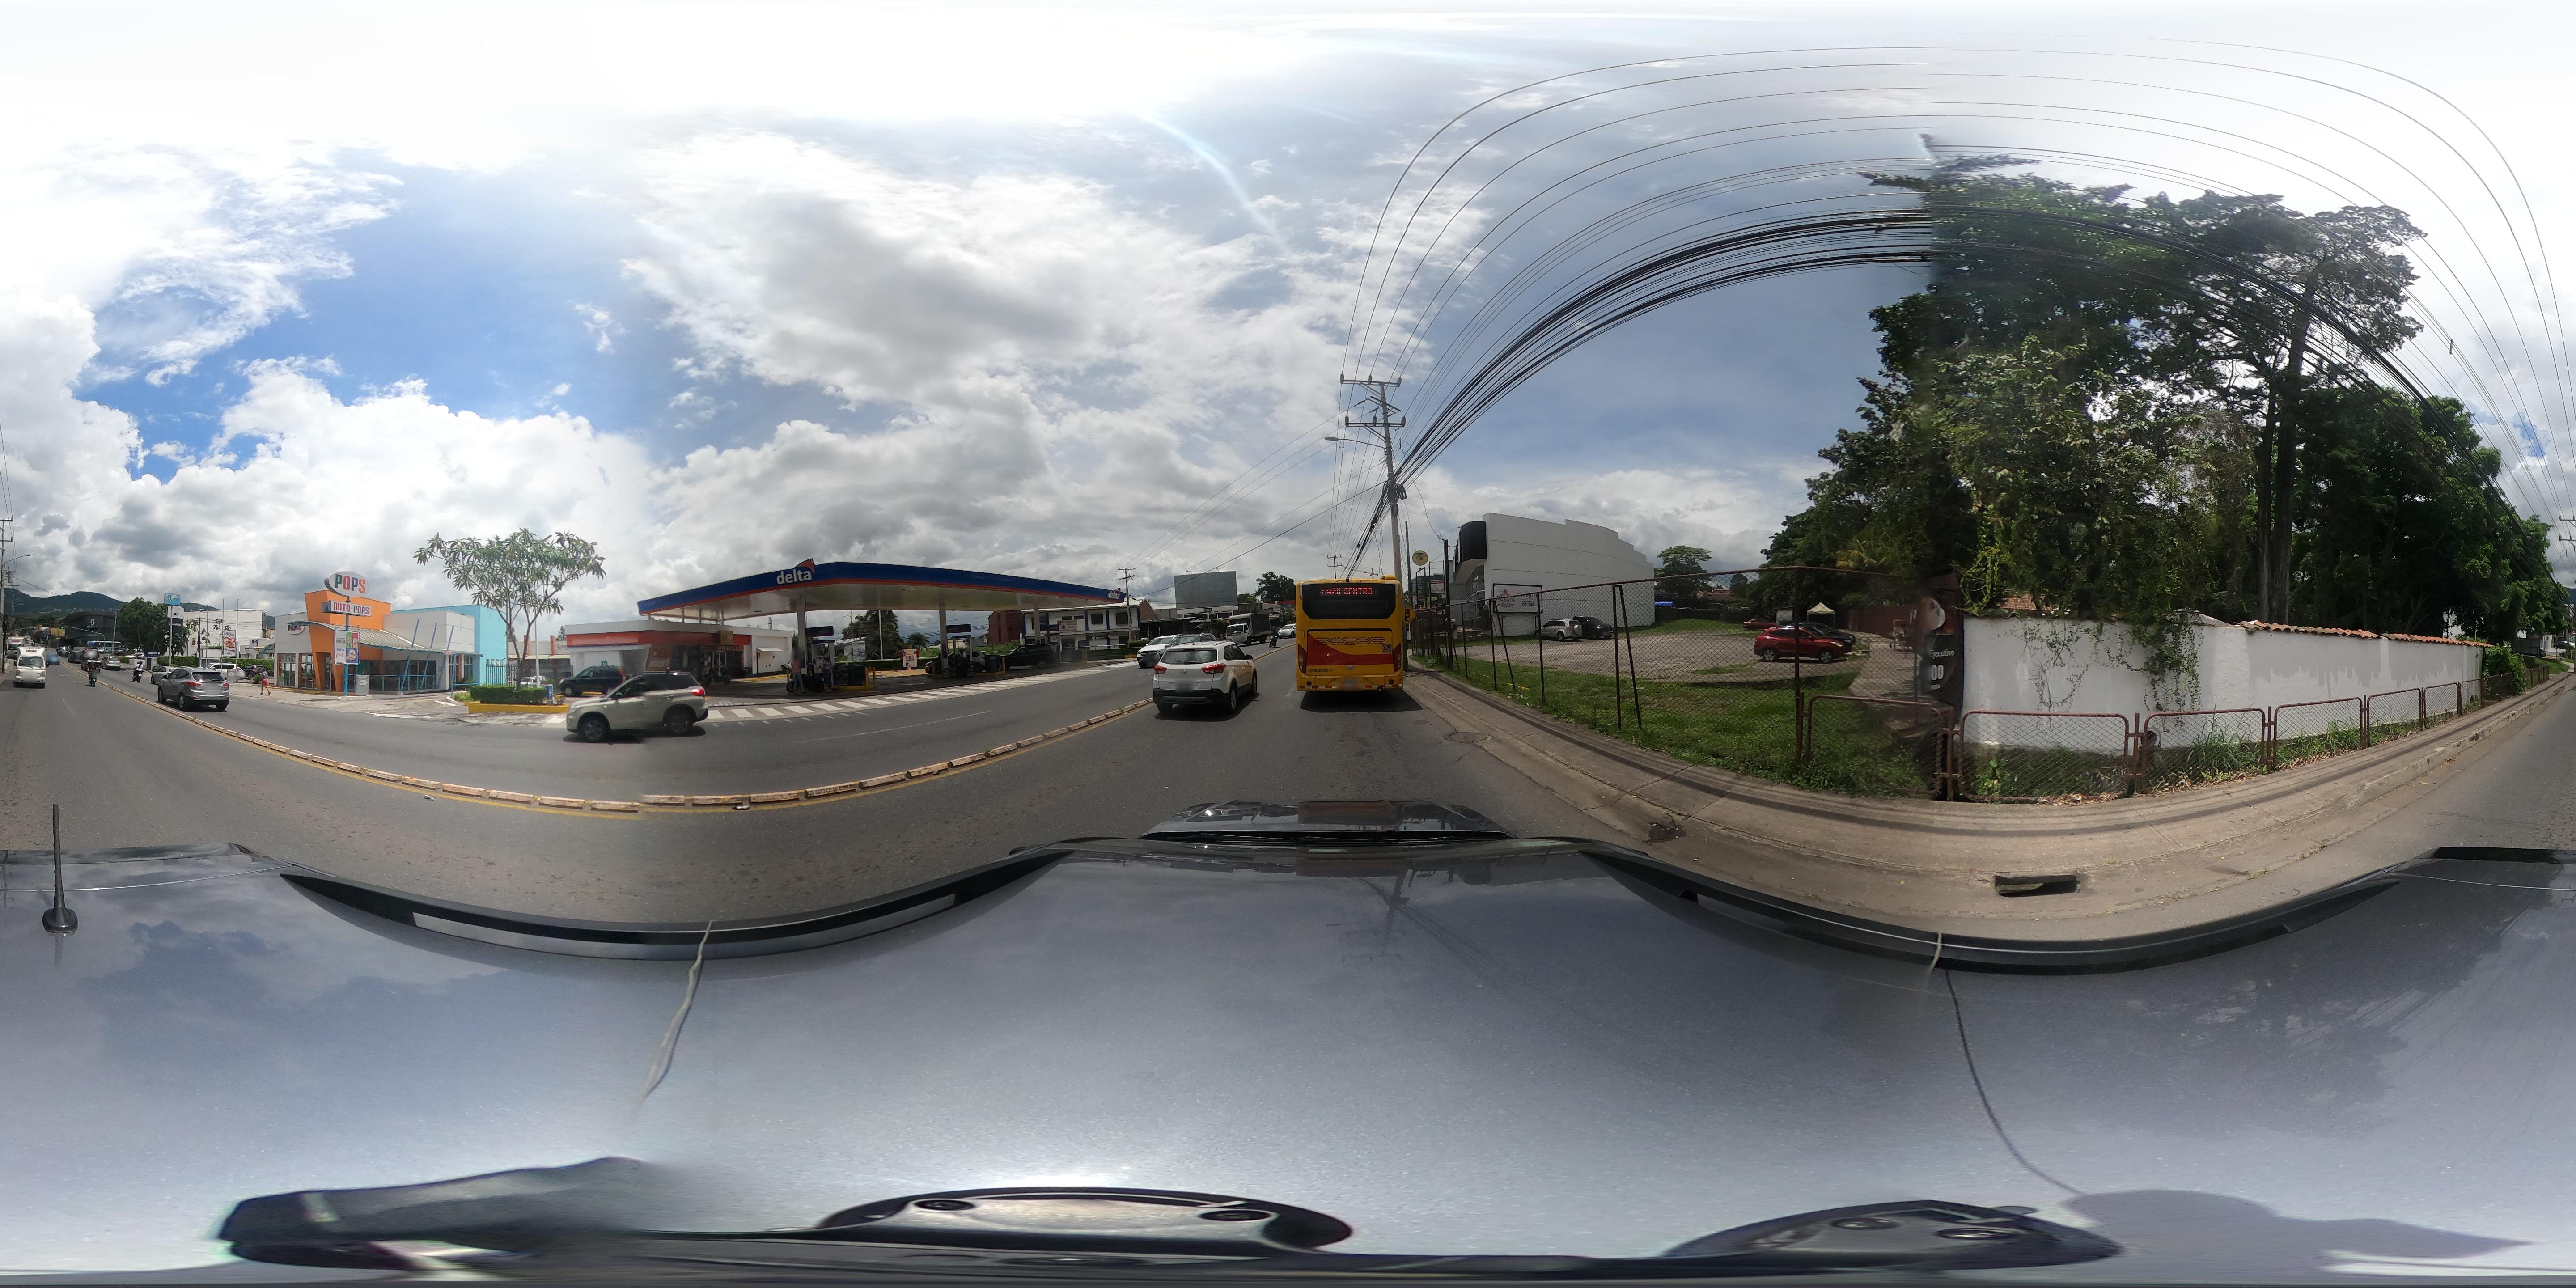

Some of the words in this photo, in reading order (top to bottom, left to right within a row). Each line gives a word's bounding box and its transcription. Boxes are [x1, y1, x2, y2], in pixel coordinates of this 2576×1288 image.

[335, 574, 365, 593] POPS
[776, 569, 812, 585] delta
[1107, 590, 1120, 599] delta
[333, 602, 350, 612] AUTO
[353, 605, 369, 614] POPS
